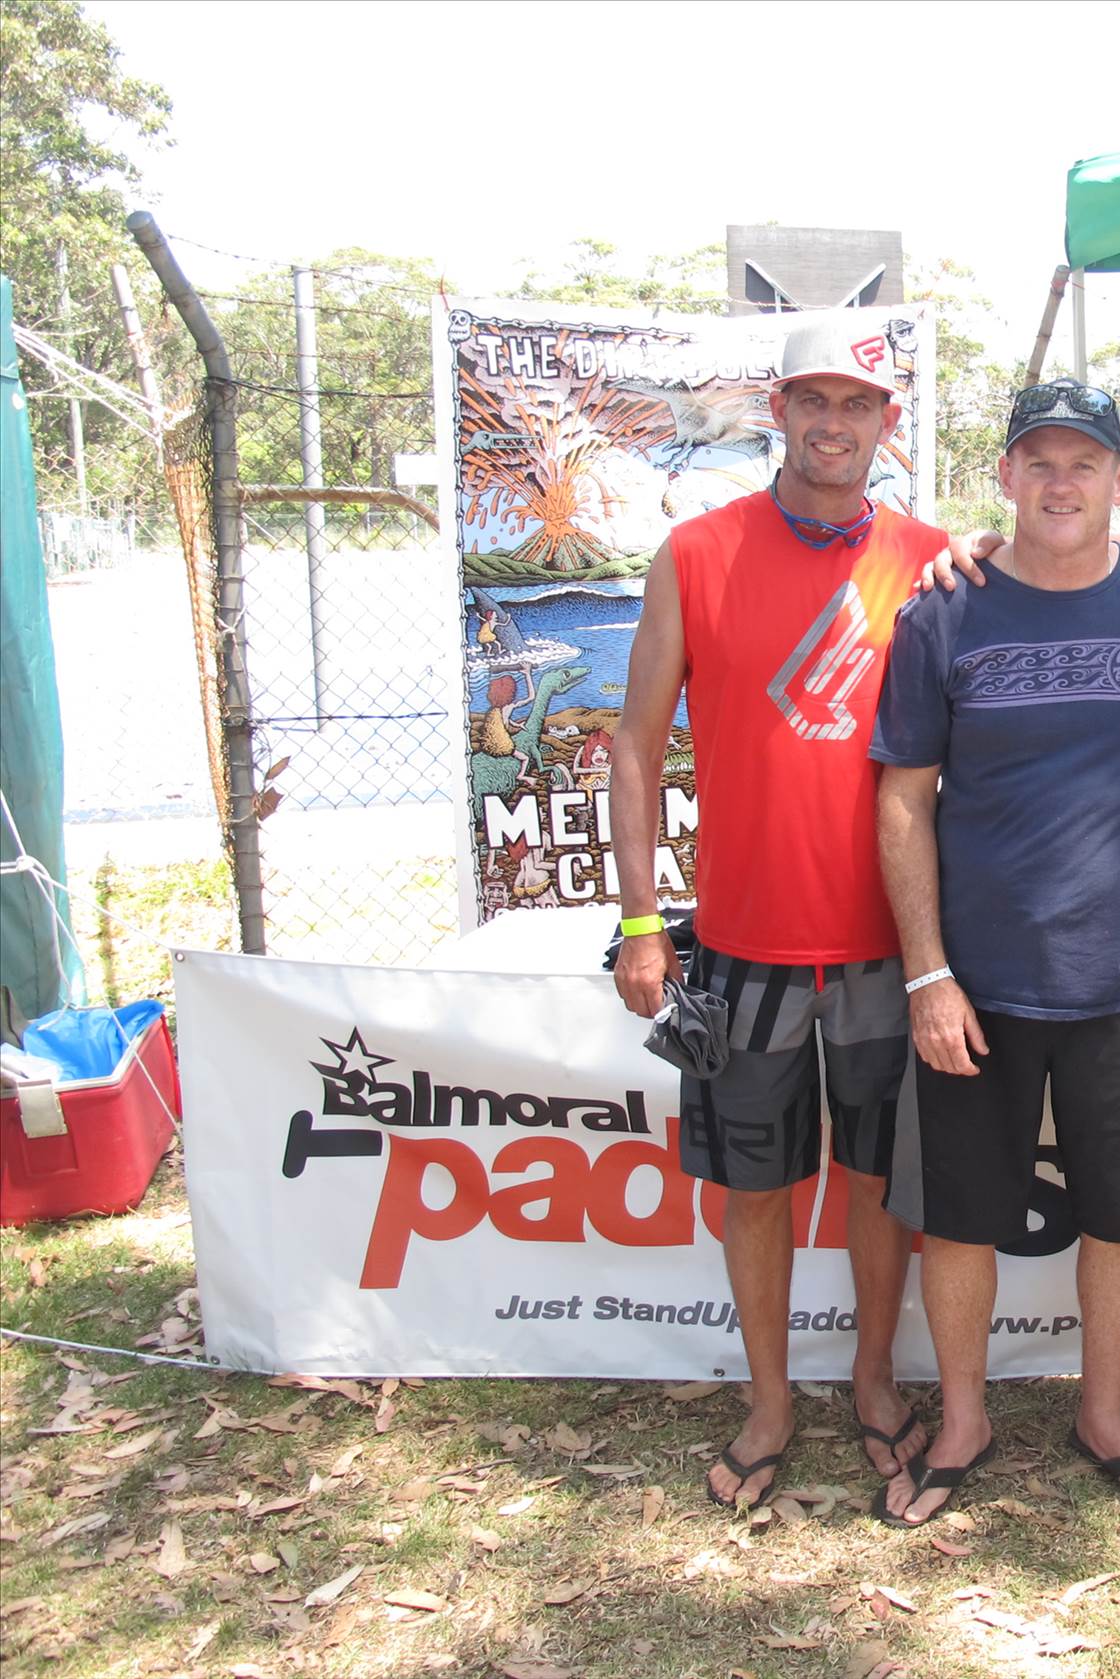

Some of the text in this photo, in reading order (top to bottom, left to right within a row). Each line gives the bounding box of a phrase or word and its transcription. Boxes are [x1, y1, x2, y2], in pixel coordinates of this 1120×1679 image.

[476, 333, 560, 380] THE
[321, 1070, 652, 1135] Balmoral
[495, 1295, 584, 1321] Just
